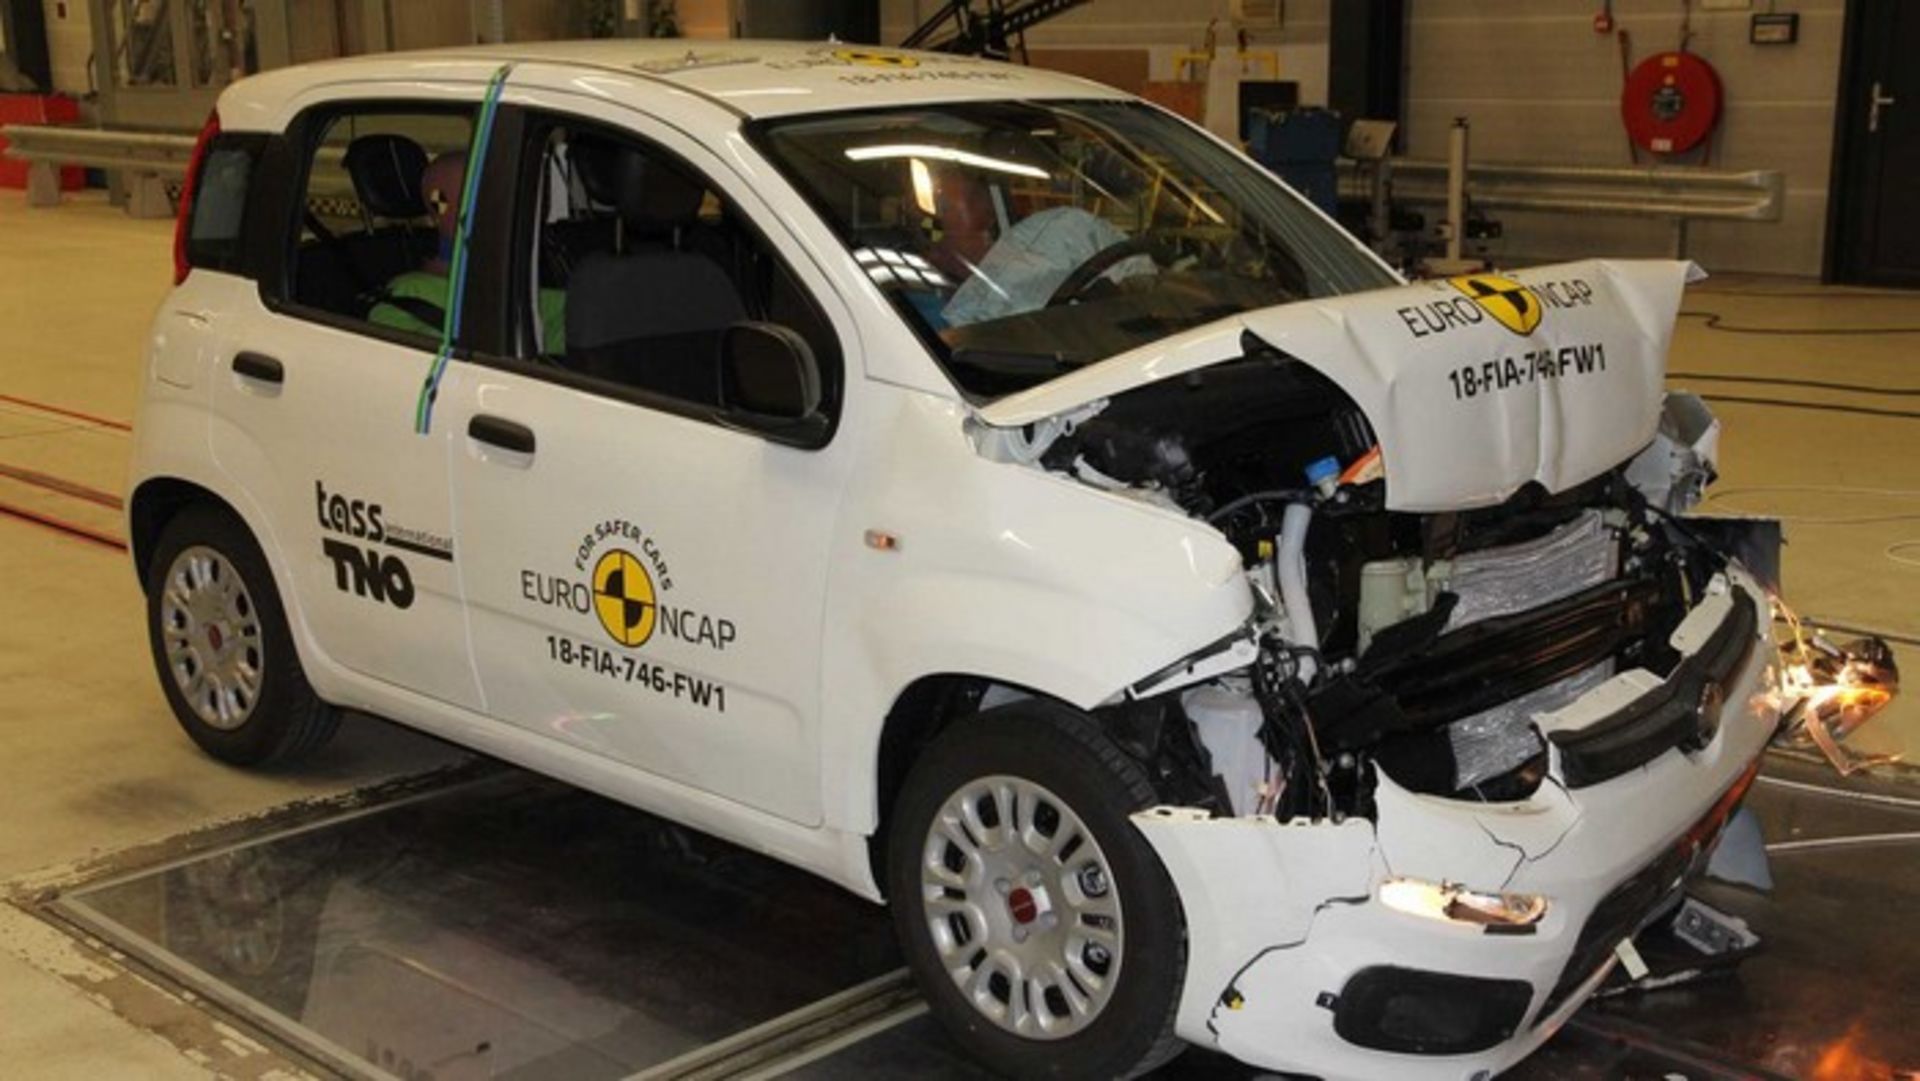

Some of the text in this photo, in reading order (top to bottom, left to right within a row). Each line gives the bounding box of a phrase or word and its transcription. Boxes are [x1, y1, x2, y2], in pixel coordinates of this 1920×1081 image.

[1396, 278, 1593, 338] EURO NCAP
[1448, 343, 1607, 400] 18-FIA-746FW1
[322, 537, 415, 610] TNO
[575, 520, 673, 591] FOR SAFER CARS
[521, 570, 736, 650] EURO NCAP
[546, 635, 726, 713] 18-FIA-746-FW1
